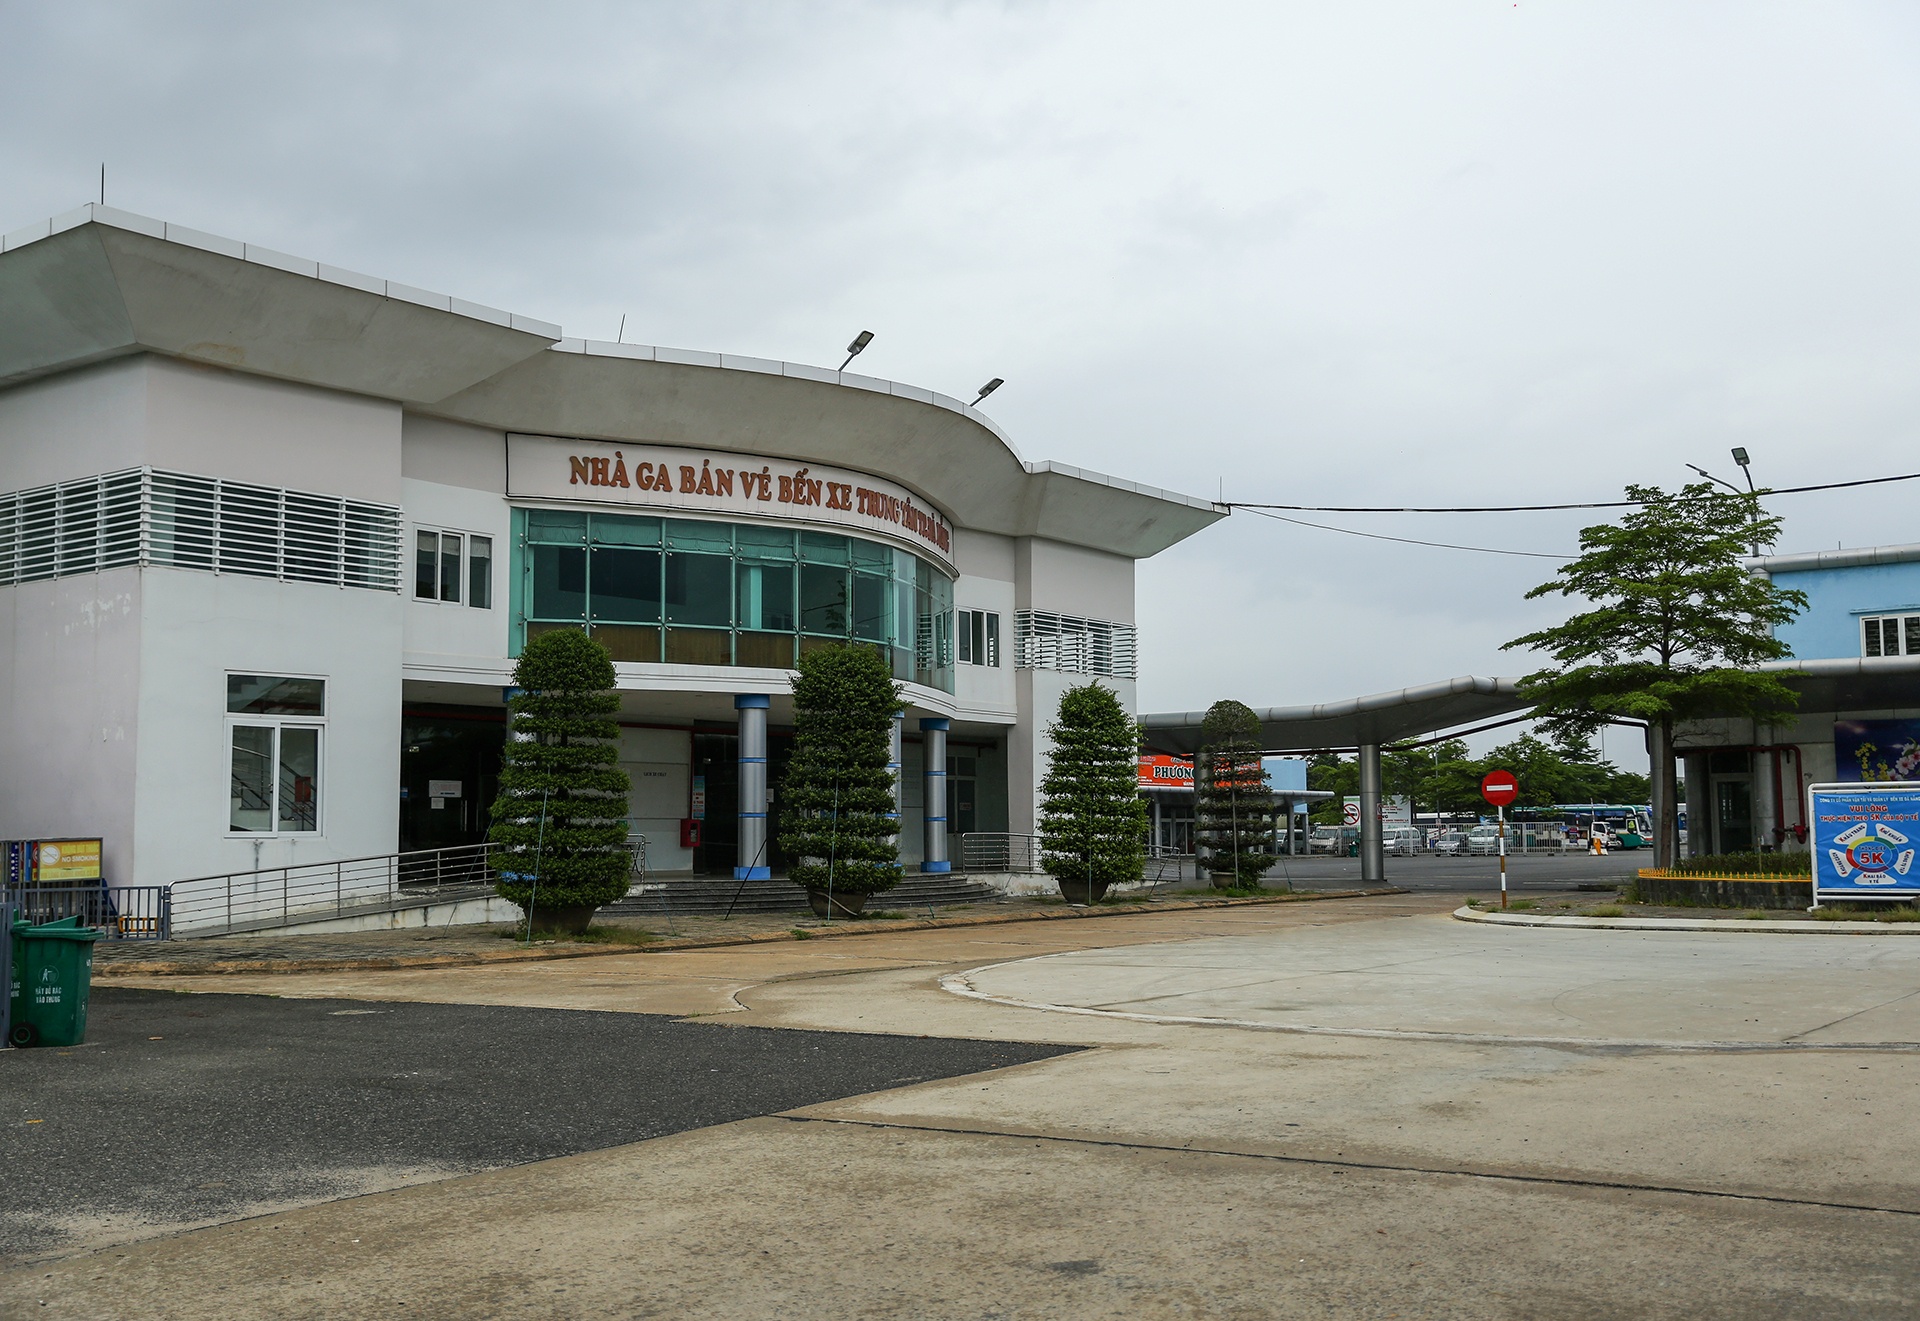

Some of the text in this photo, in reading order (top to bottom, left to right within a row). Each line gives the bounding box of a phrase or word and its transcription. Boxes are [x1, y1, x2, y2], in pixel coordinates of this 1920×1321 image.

[570, 451, 630, 488] NHÀ
[636, 462, 673, 492] GA
[679, 459, 734, 497] BÁN
[740, 466, 772, 501] VÉ
[778, 468, 822, 506] BẾN
[826, 482, 852, 511] XE
[856, 487, 901, 524] TRUNG
[1865, 803, 1888, 812] LÒNG
[1860, 852, 1885, 864] 5K
